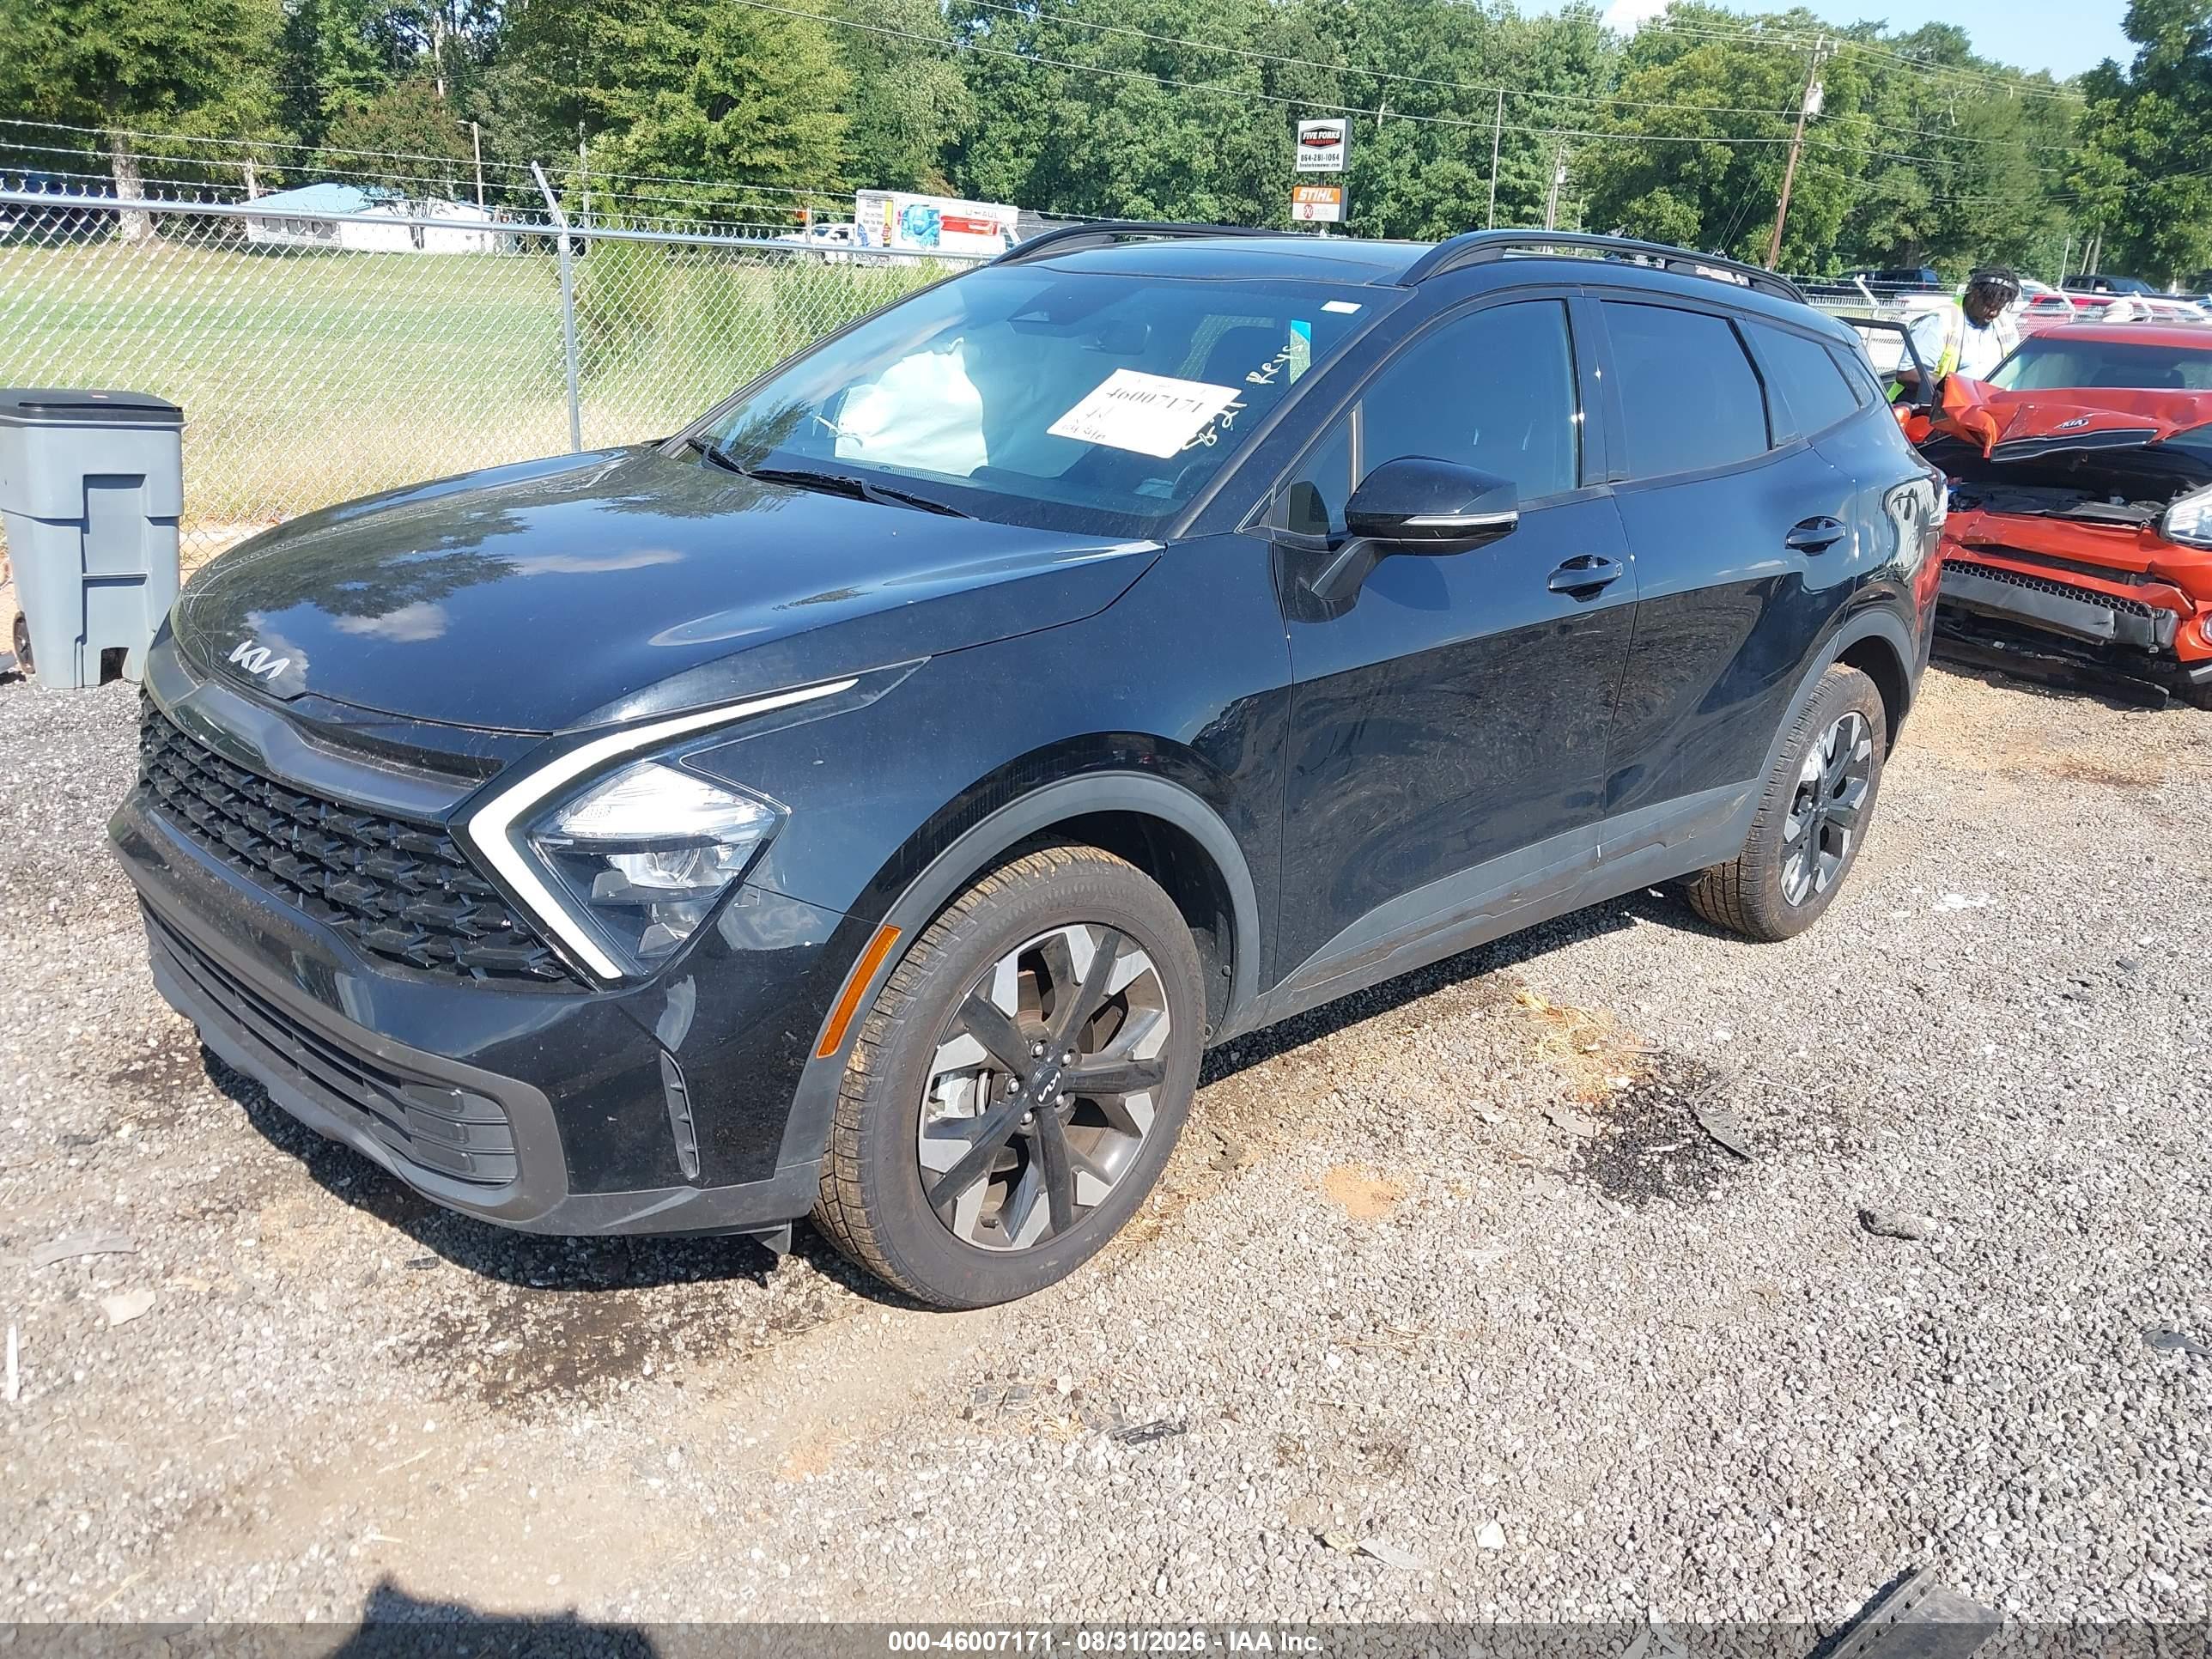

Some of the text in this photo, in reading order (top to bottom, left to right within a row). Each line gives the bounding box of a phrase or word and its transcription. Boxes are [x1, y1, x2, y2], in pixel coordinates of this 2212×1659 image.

[1302, 131, 1340, 140] FIVE FORKS
[1297, 188, 1334, 201] STIHL
[1105, 387, 1205, 413] 46007171
[2061, 419, 2084, 428] KIA
